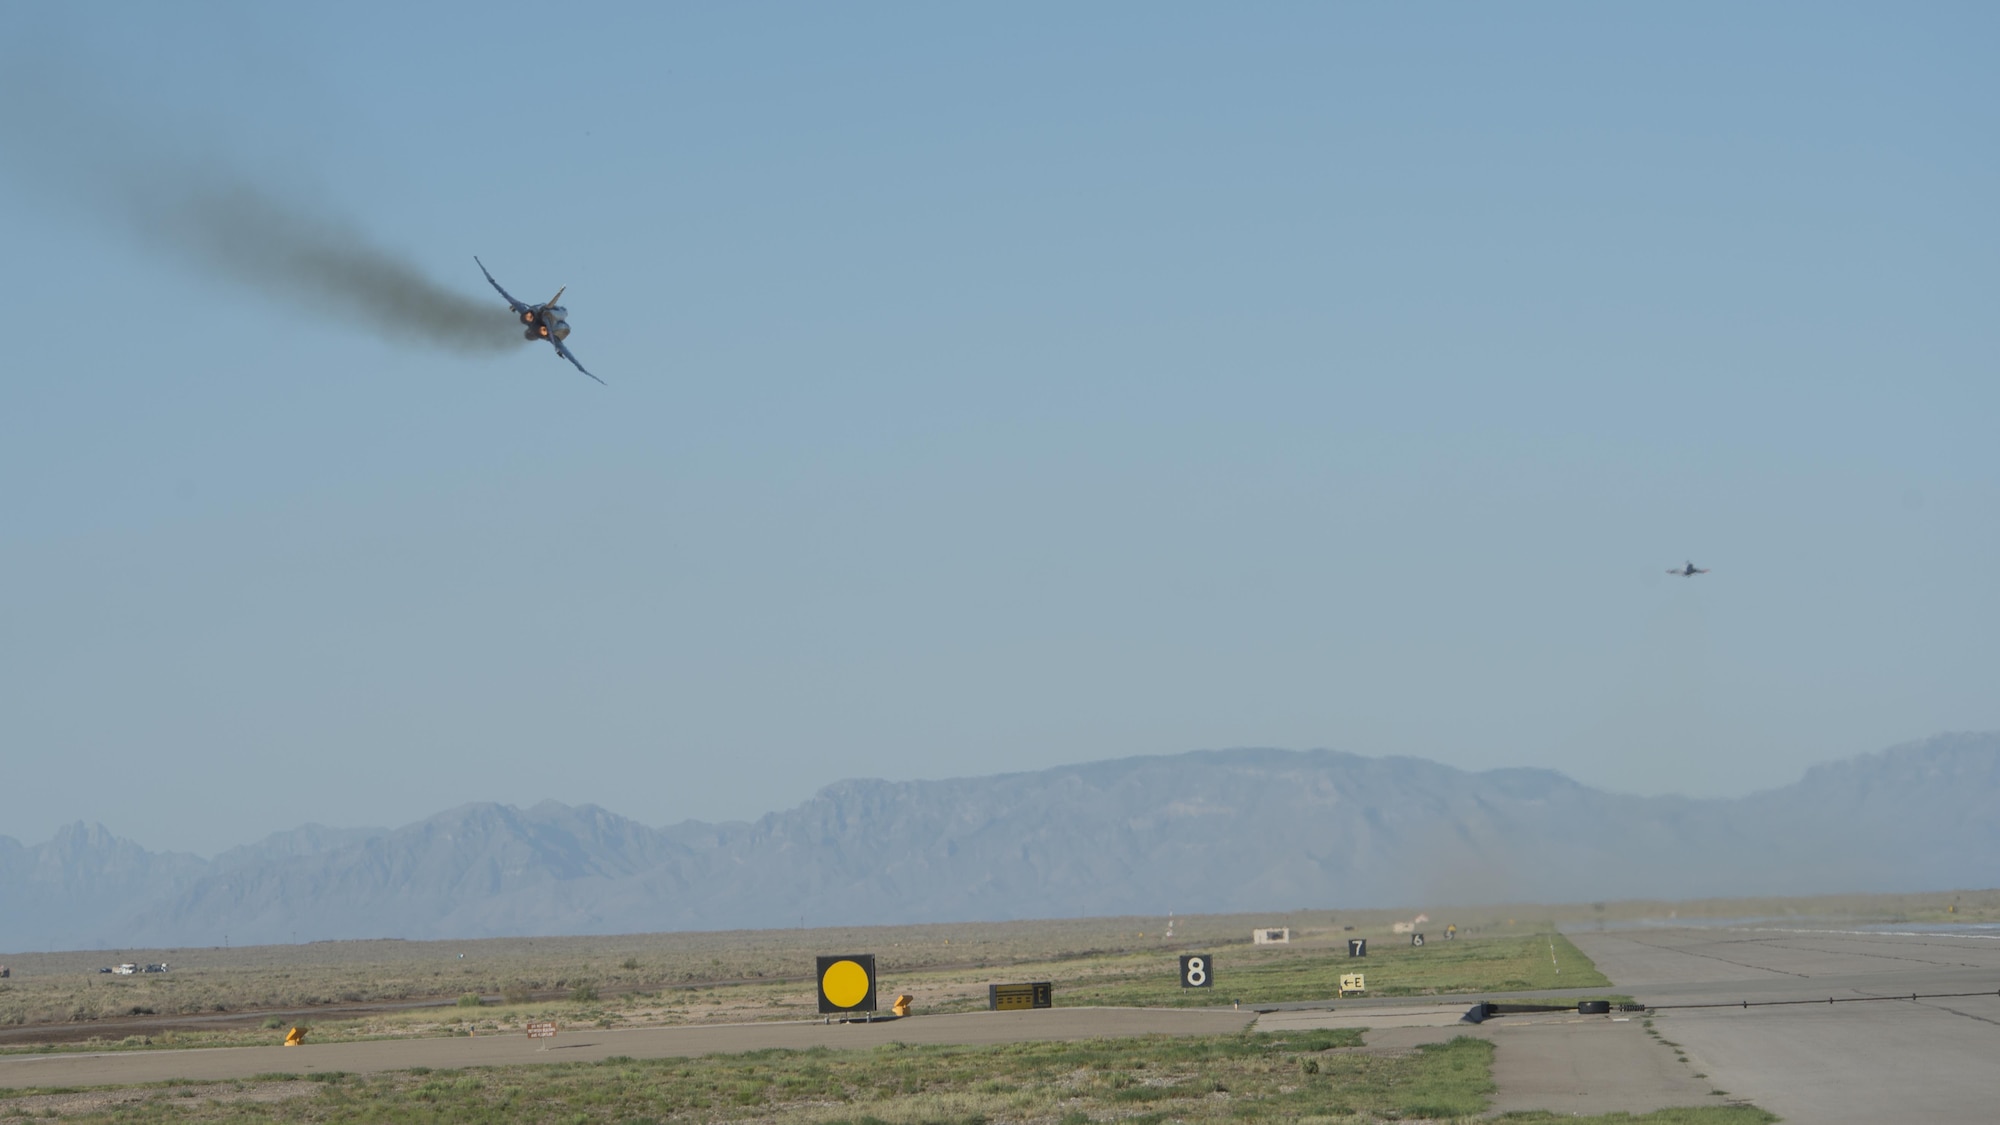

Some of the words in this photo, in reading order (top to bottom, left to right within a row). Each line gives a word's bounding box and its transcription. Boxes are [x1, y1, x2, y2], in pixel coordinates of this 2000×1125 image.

[1352, 940, 1362, 956] 7
[1414, 935, 1423, 946] 6
[1187, 957, 1206, 986] 8
[1355, 977, 1361, 987] E
[1038, 987, 1045, 1003] E
